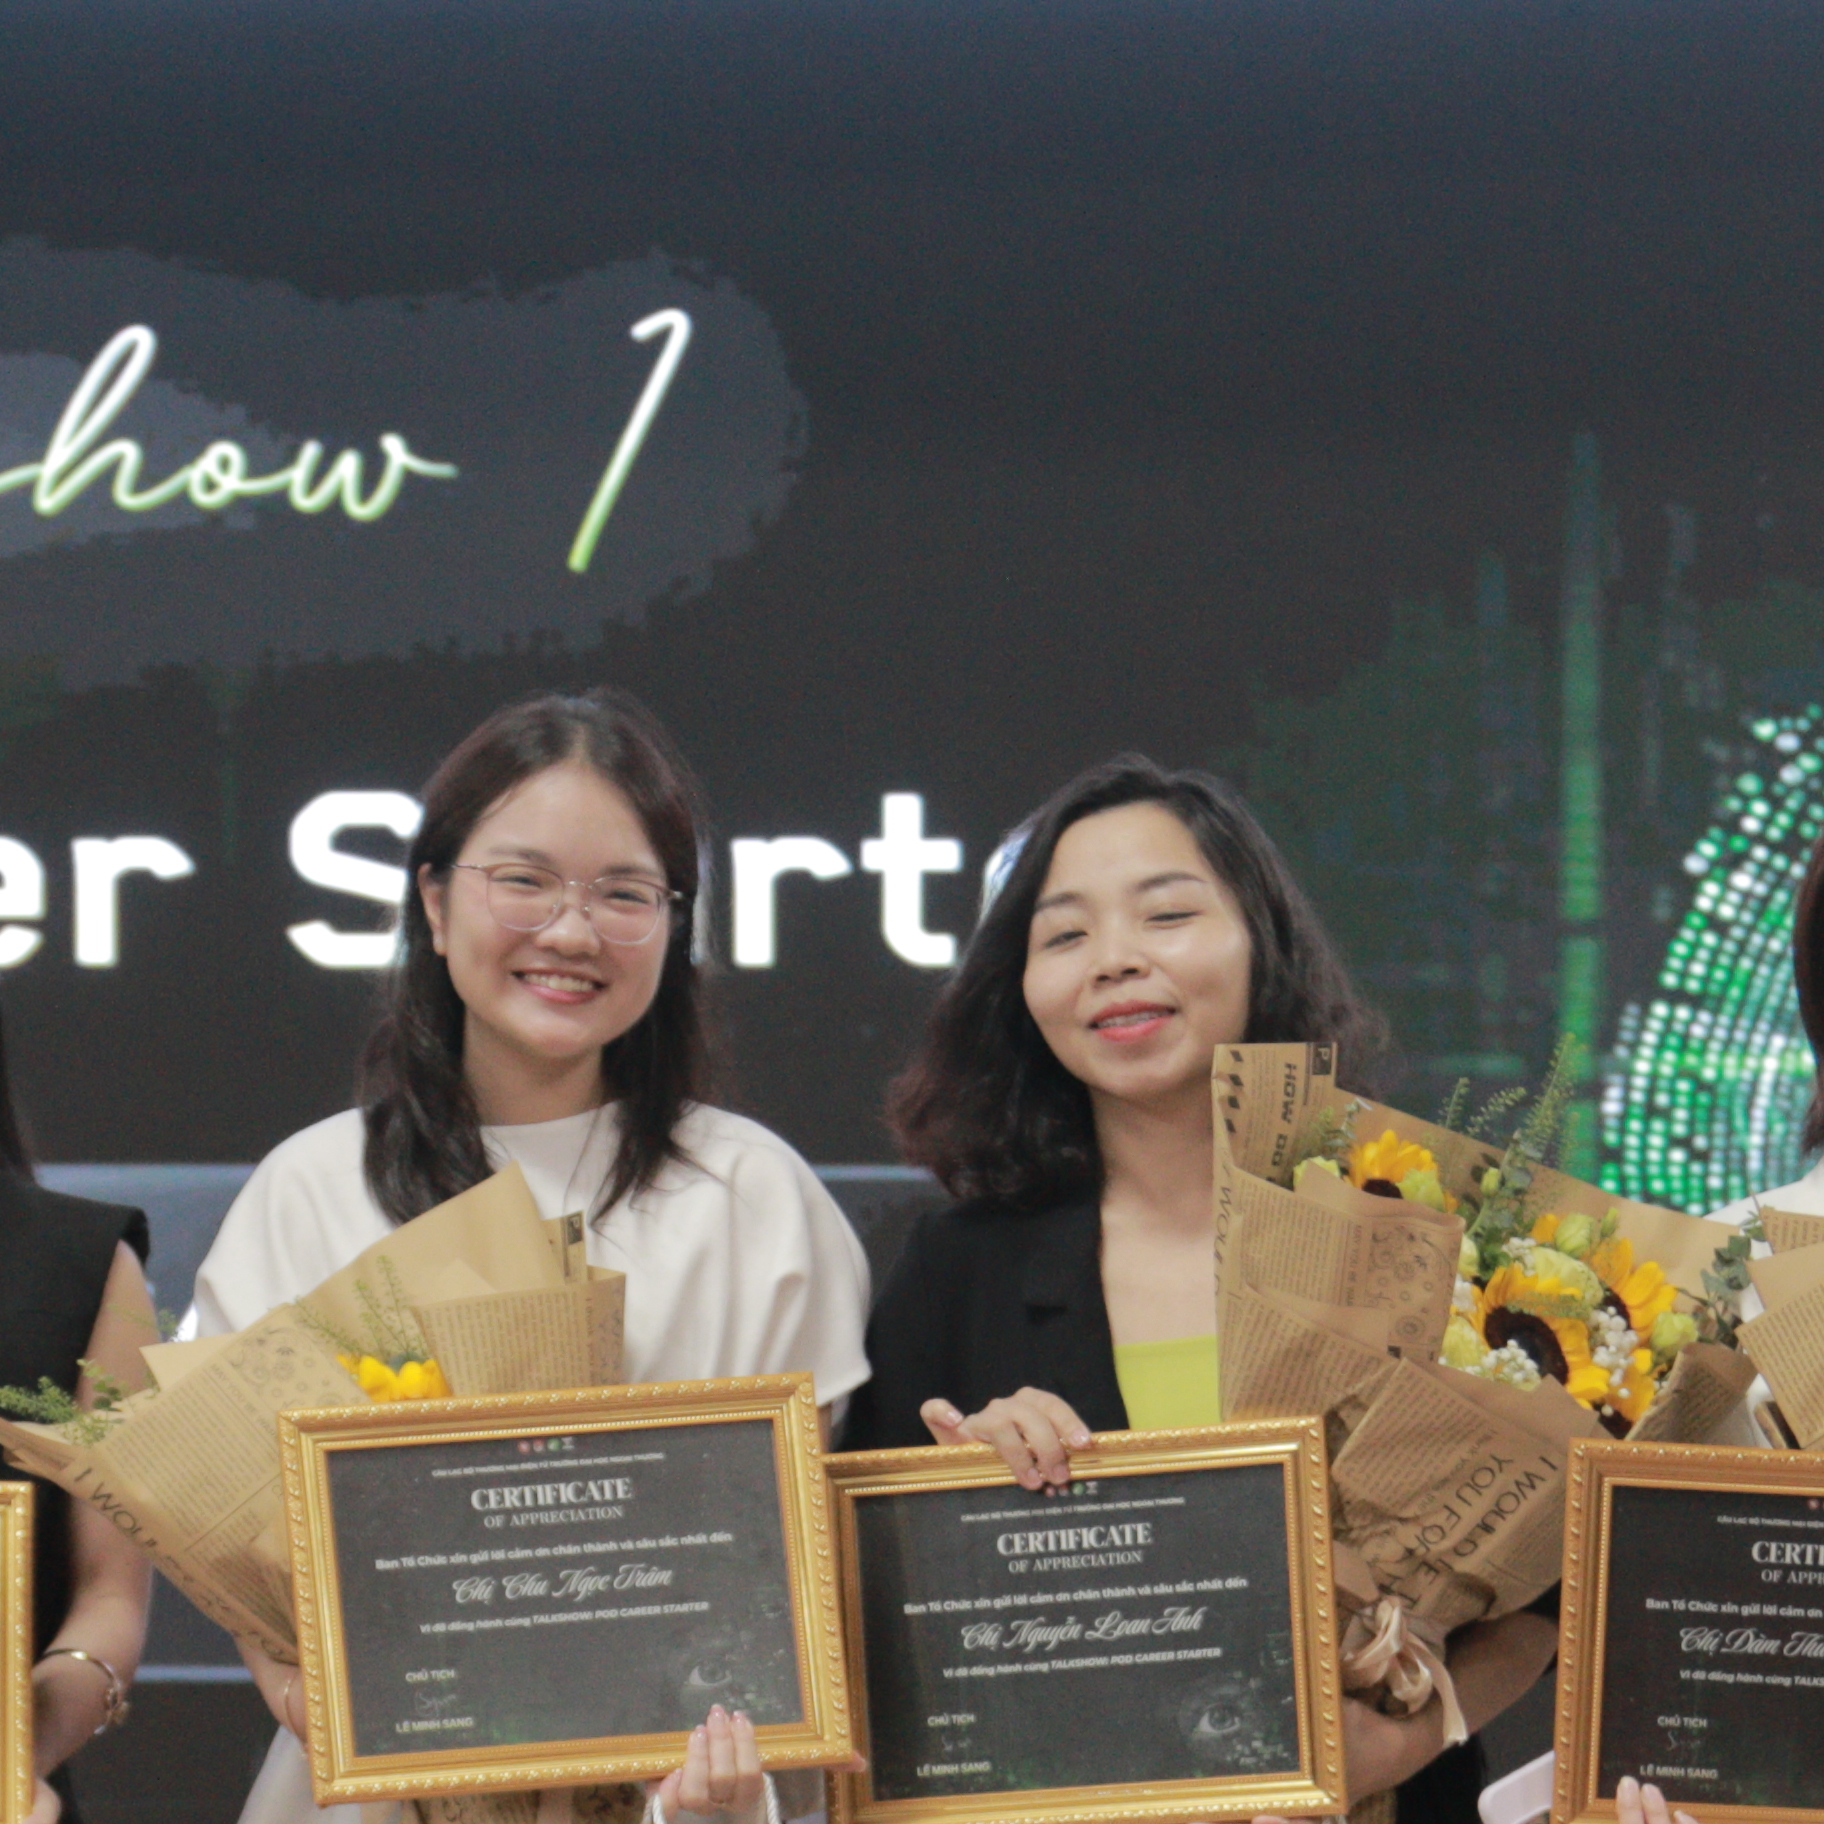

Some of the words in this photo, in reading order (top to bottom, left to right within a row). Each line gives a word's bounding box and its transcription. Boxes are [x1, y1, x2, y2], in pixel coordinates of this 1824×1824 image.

[570, 308, 692, 572] 1
[469, 1475, 633, 1512] CERTIFICATE
[1454, 1454, 1514, 1507] YOU
[483, 1514, 505, 1529] OF
[508, 1504, 624, 1527] APPRECIATION
[995, 1520, 1152, 1557] CERTIFICATE
[1007, 1559, 1028, 1574] OF
[1032, 1549, 1143, 1572] APPRECIATION
[1760, 1568, 1782, 1583] OF
